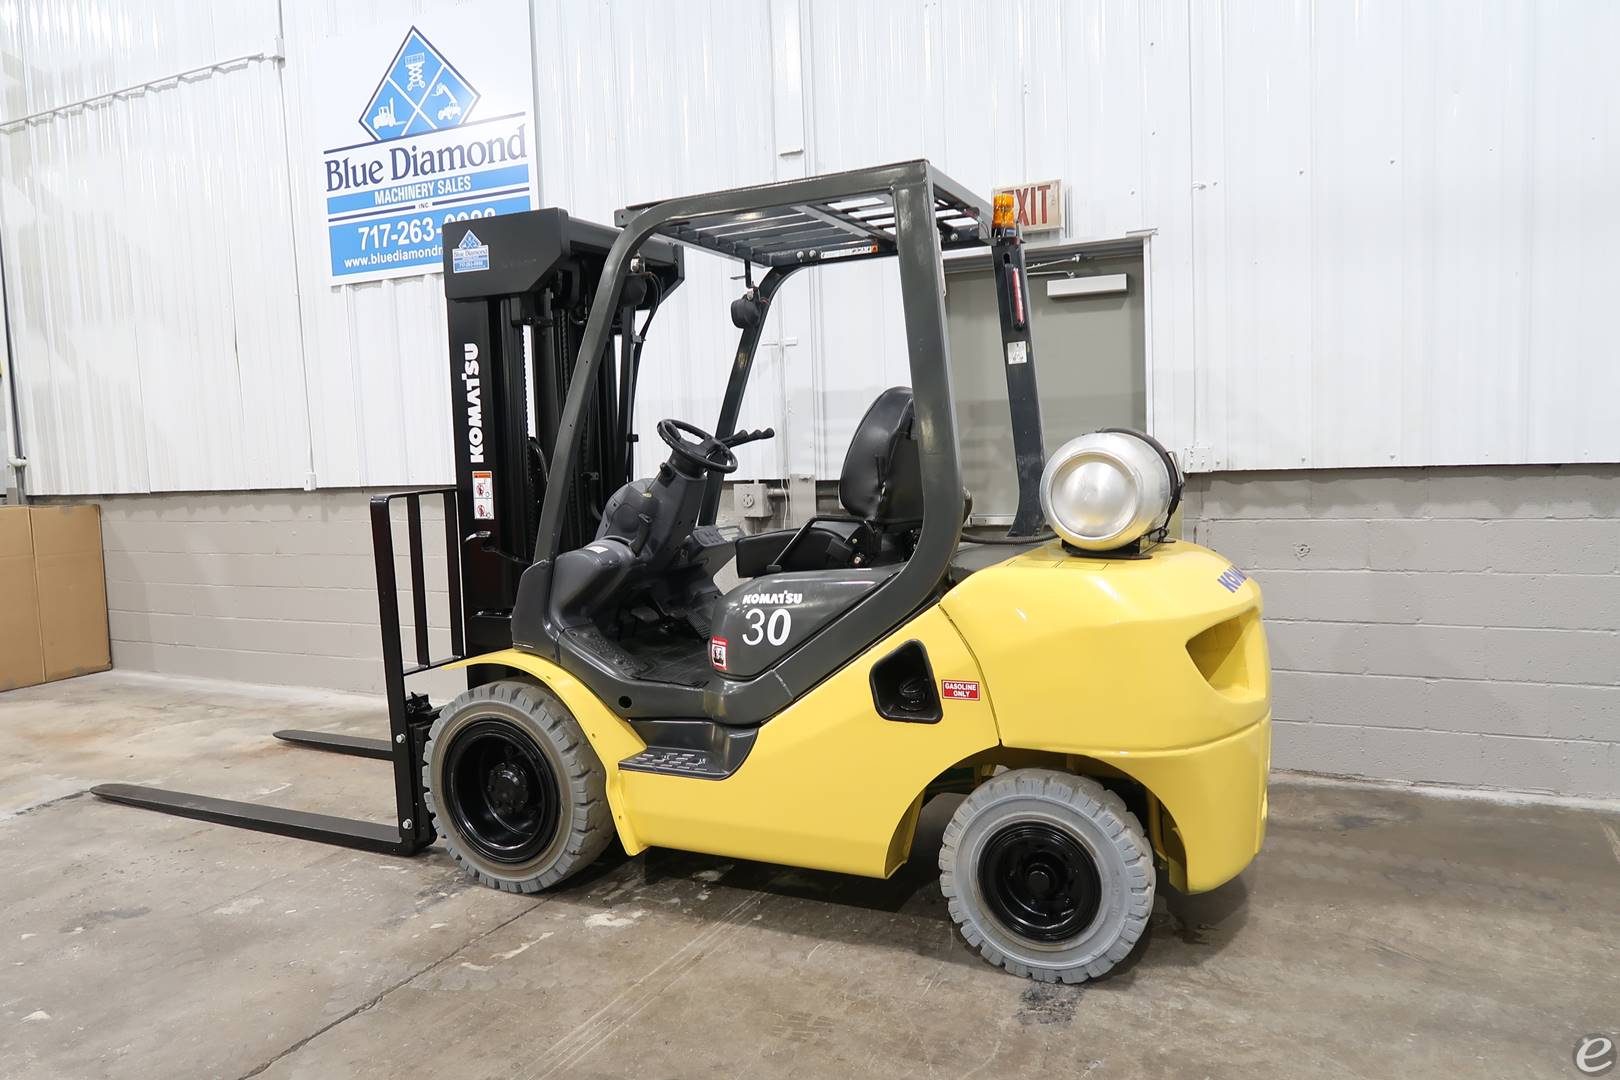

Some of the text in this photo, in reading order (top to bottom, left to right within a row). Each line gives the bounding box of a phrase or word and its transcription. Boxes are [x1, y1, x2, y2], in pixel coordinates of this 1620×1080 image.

[325, 123, 527, 192] Blue Diamond
[374, 175, 472, 205] MACHINERY SALES
[1001, 184, 1051, 226] XIT
[461, 343, 484, 463] KOMATSU
[742, 590, 803, 605] KOMATSU
[742, 608, 792, 646] 30
[944, 682, 977, 691] GASOLINE
